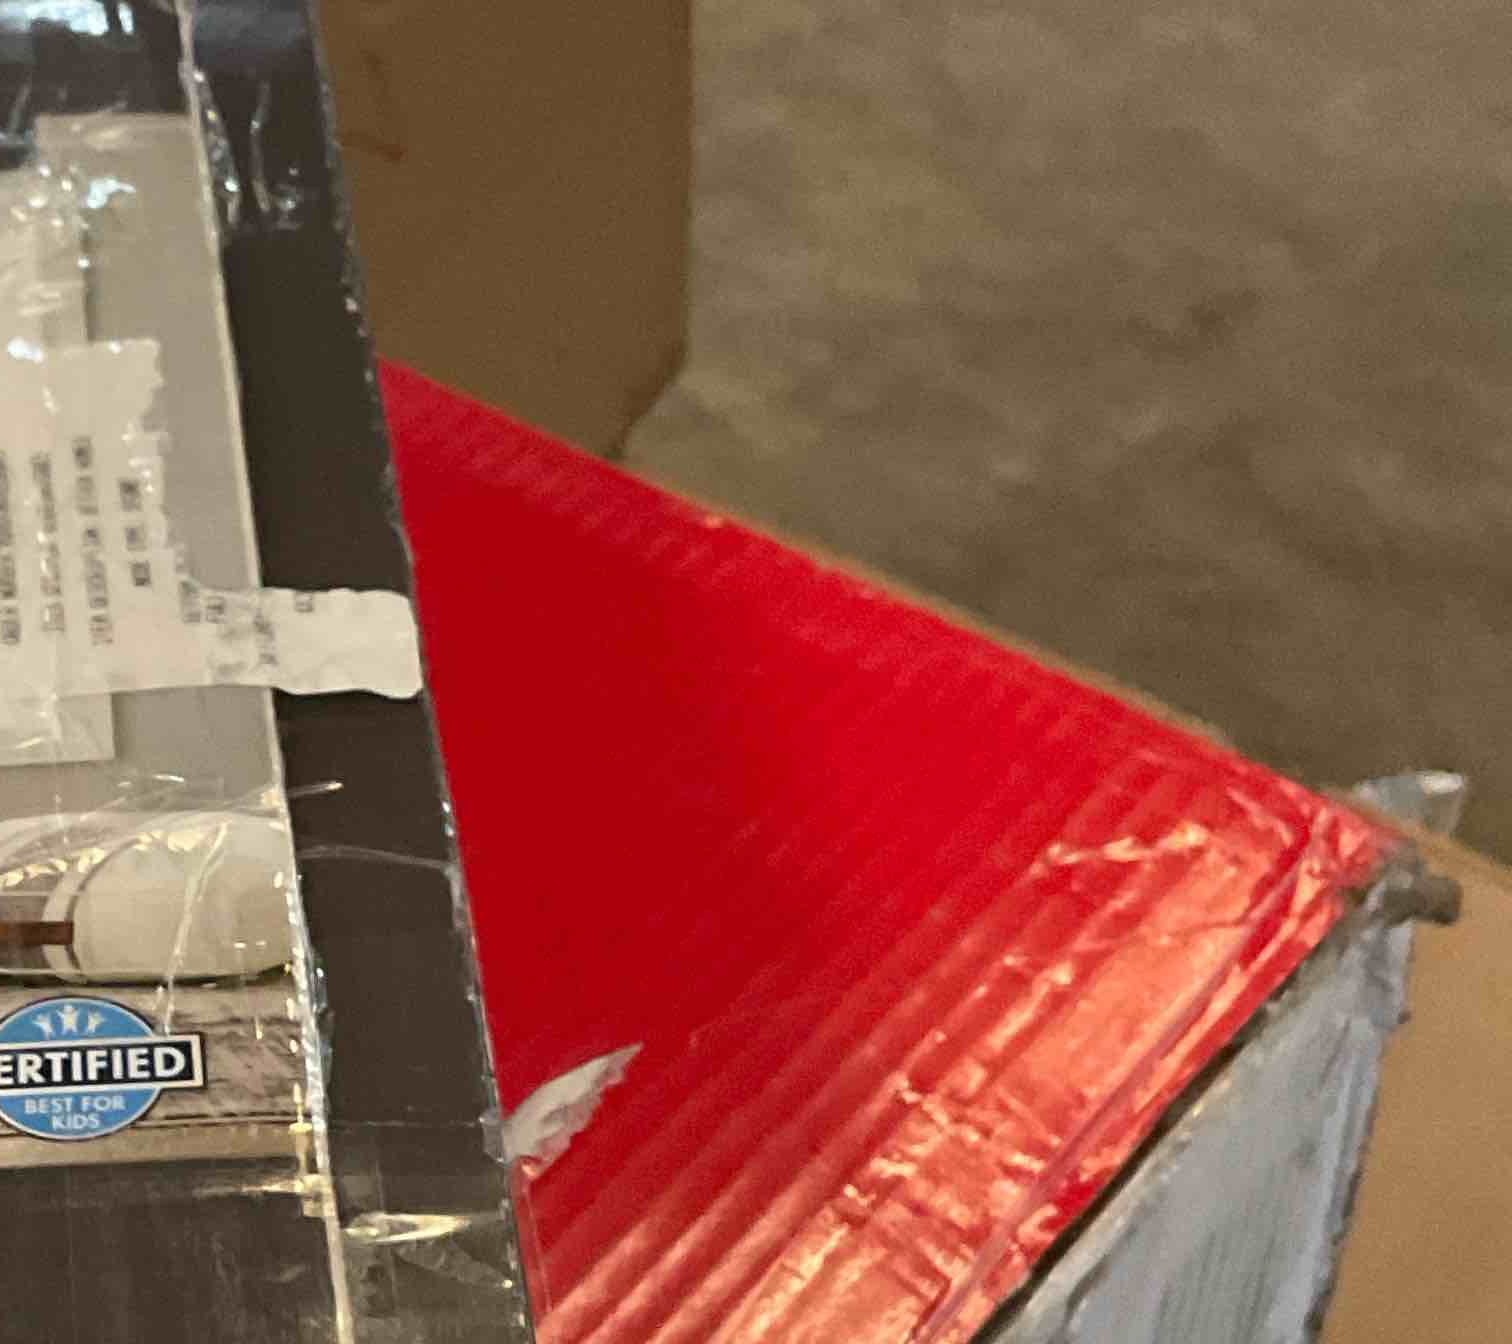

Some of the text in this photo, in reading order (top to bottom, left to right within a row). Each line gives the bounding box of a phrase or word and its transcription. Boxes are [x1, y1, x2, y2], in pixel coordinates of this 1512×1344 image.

[24, 1094, 127, 1116] BEST FOR
[51, 1113, 100, 1131] KIDS
